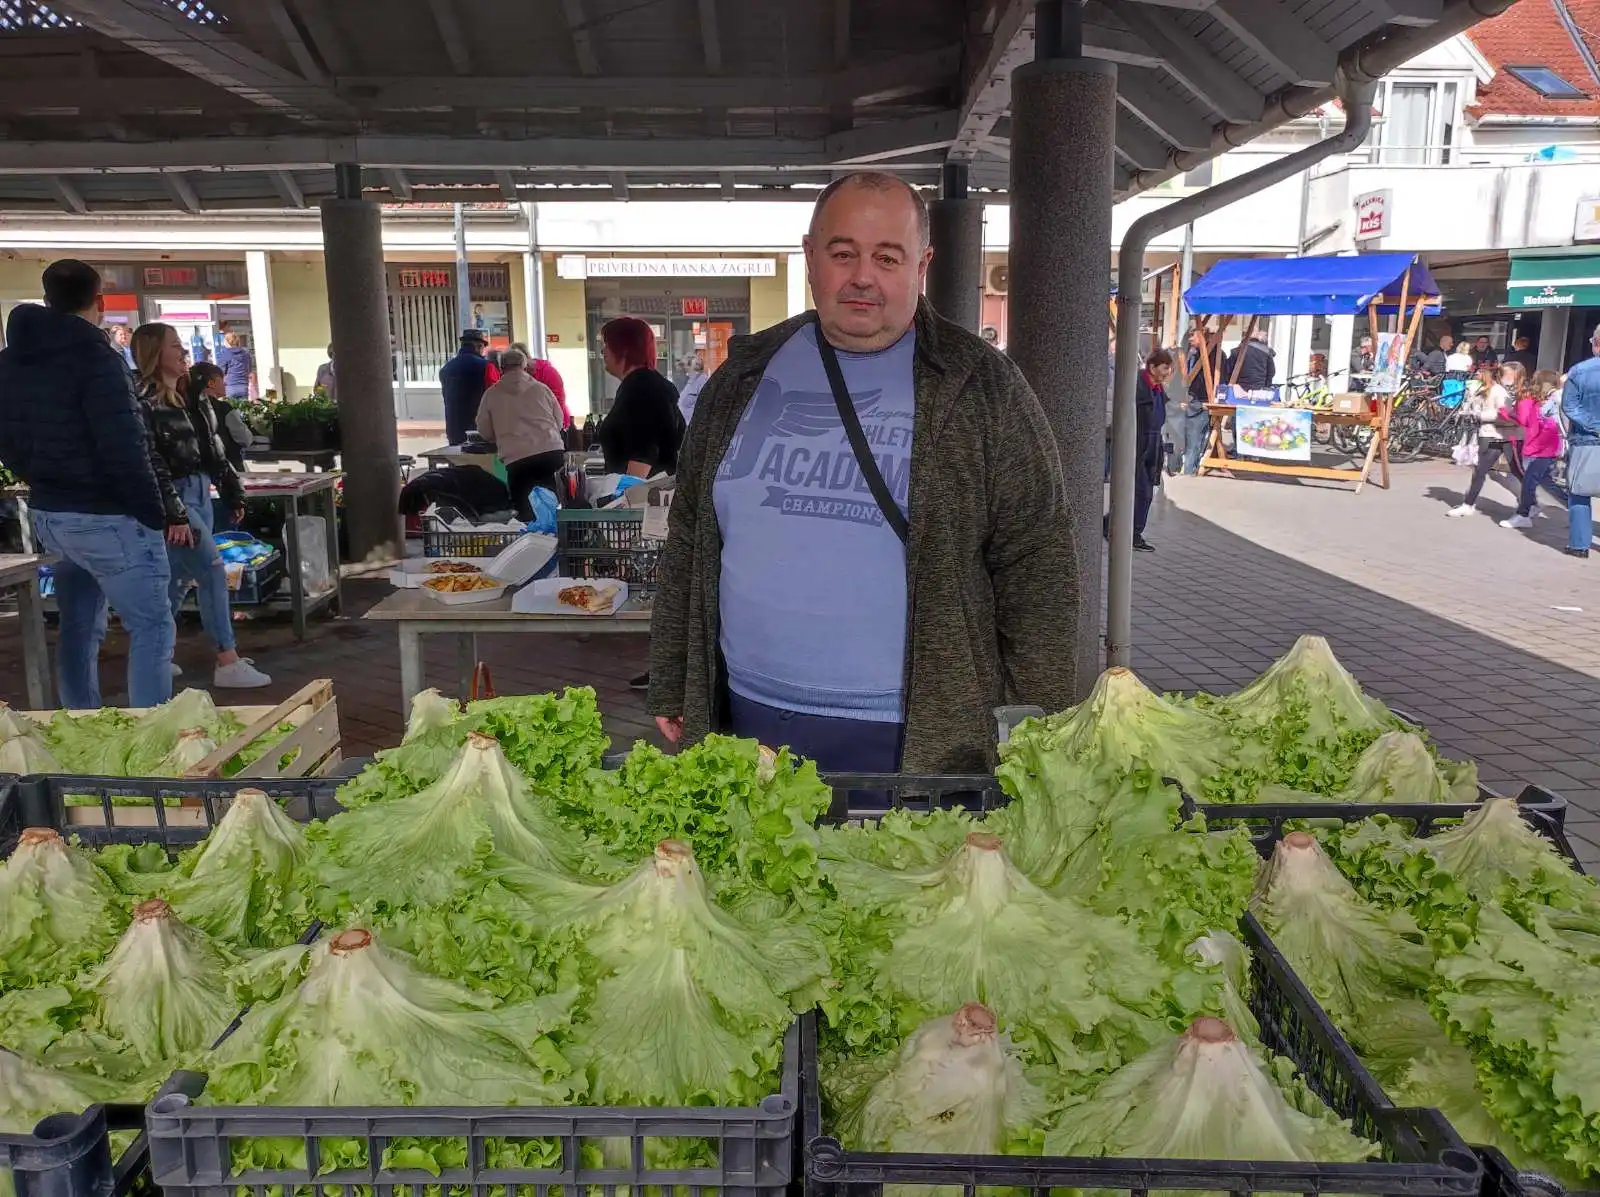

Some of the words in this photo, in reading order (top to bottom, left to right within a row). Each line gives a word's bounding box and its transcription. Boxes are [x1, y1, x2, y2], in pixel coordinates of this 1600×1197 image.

[590, 262, 667, 274] PRIVREDNA
[672, 262, 716, 274] BANKA
[721, 262, 771, 274] ZAGREB
[1523, 294, 1574, 305] Heineken
